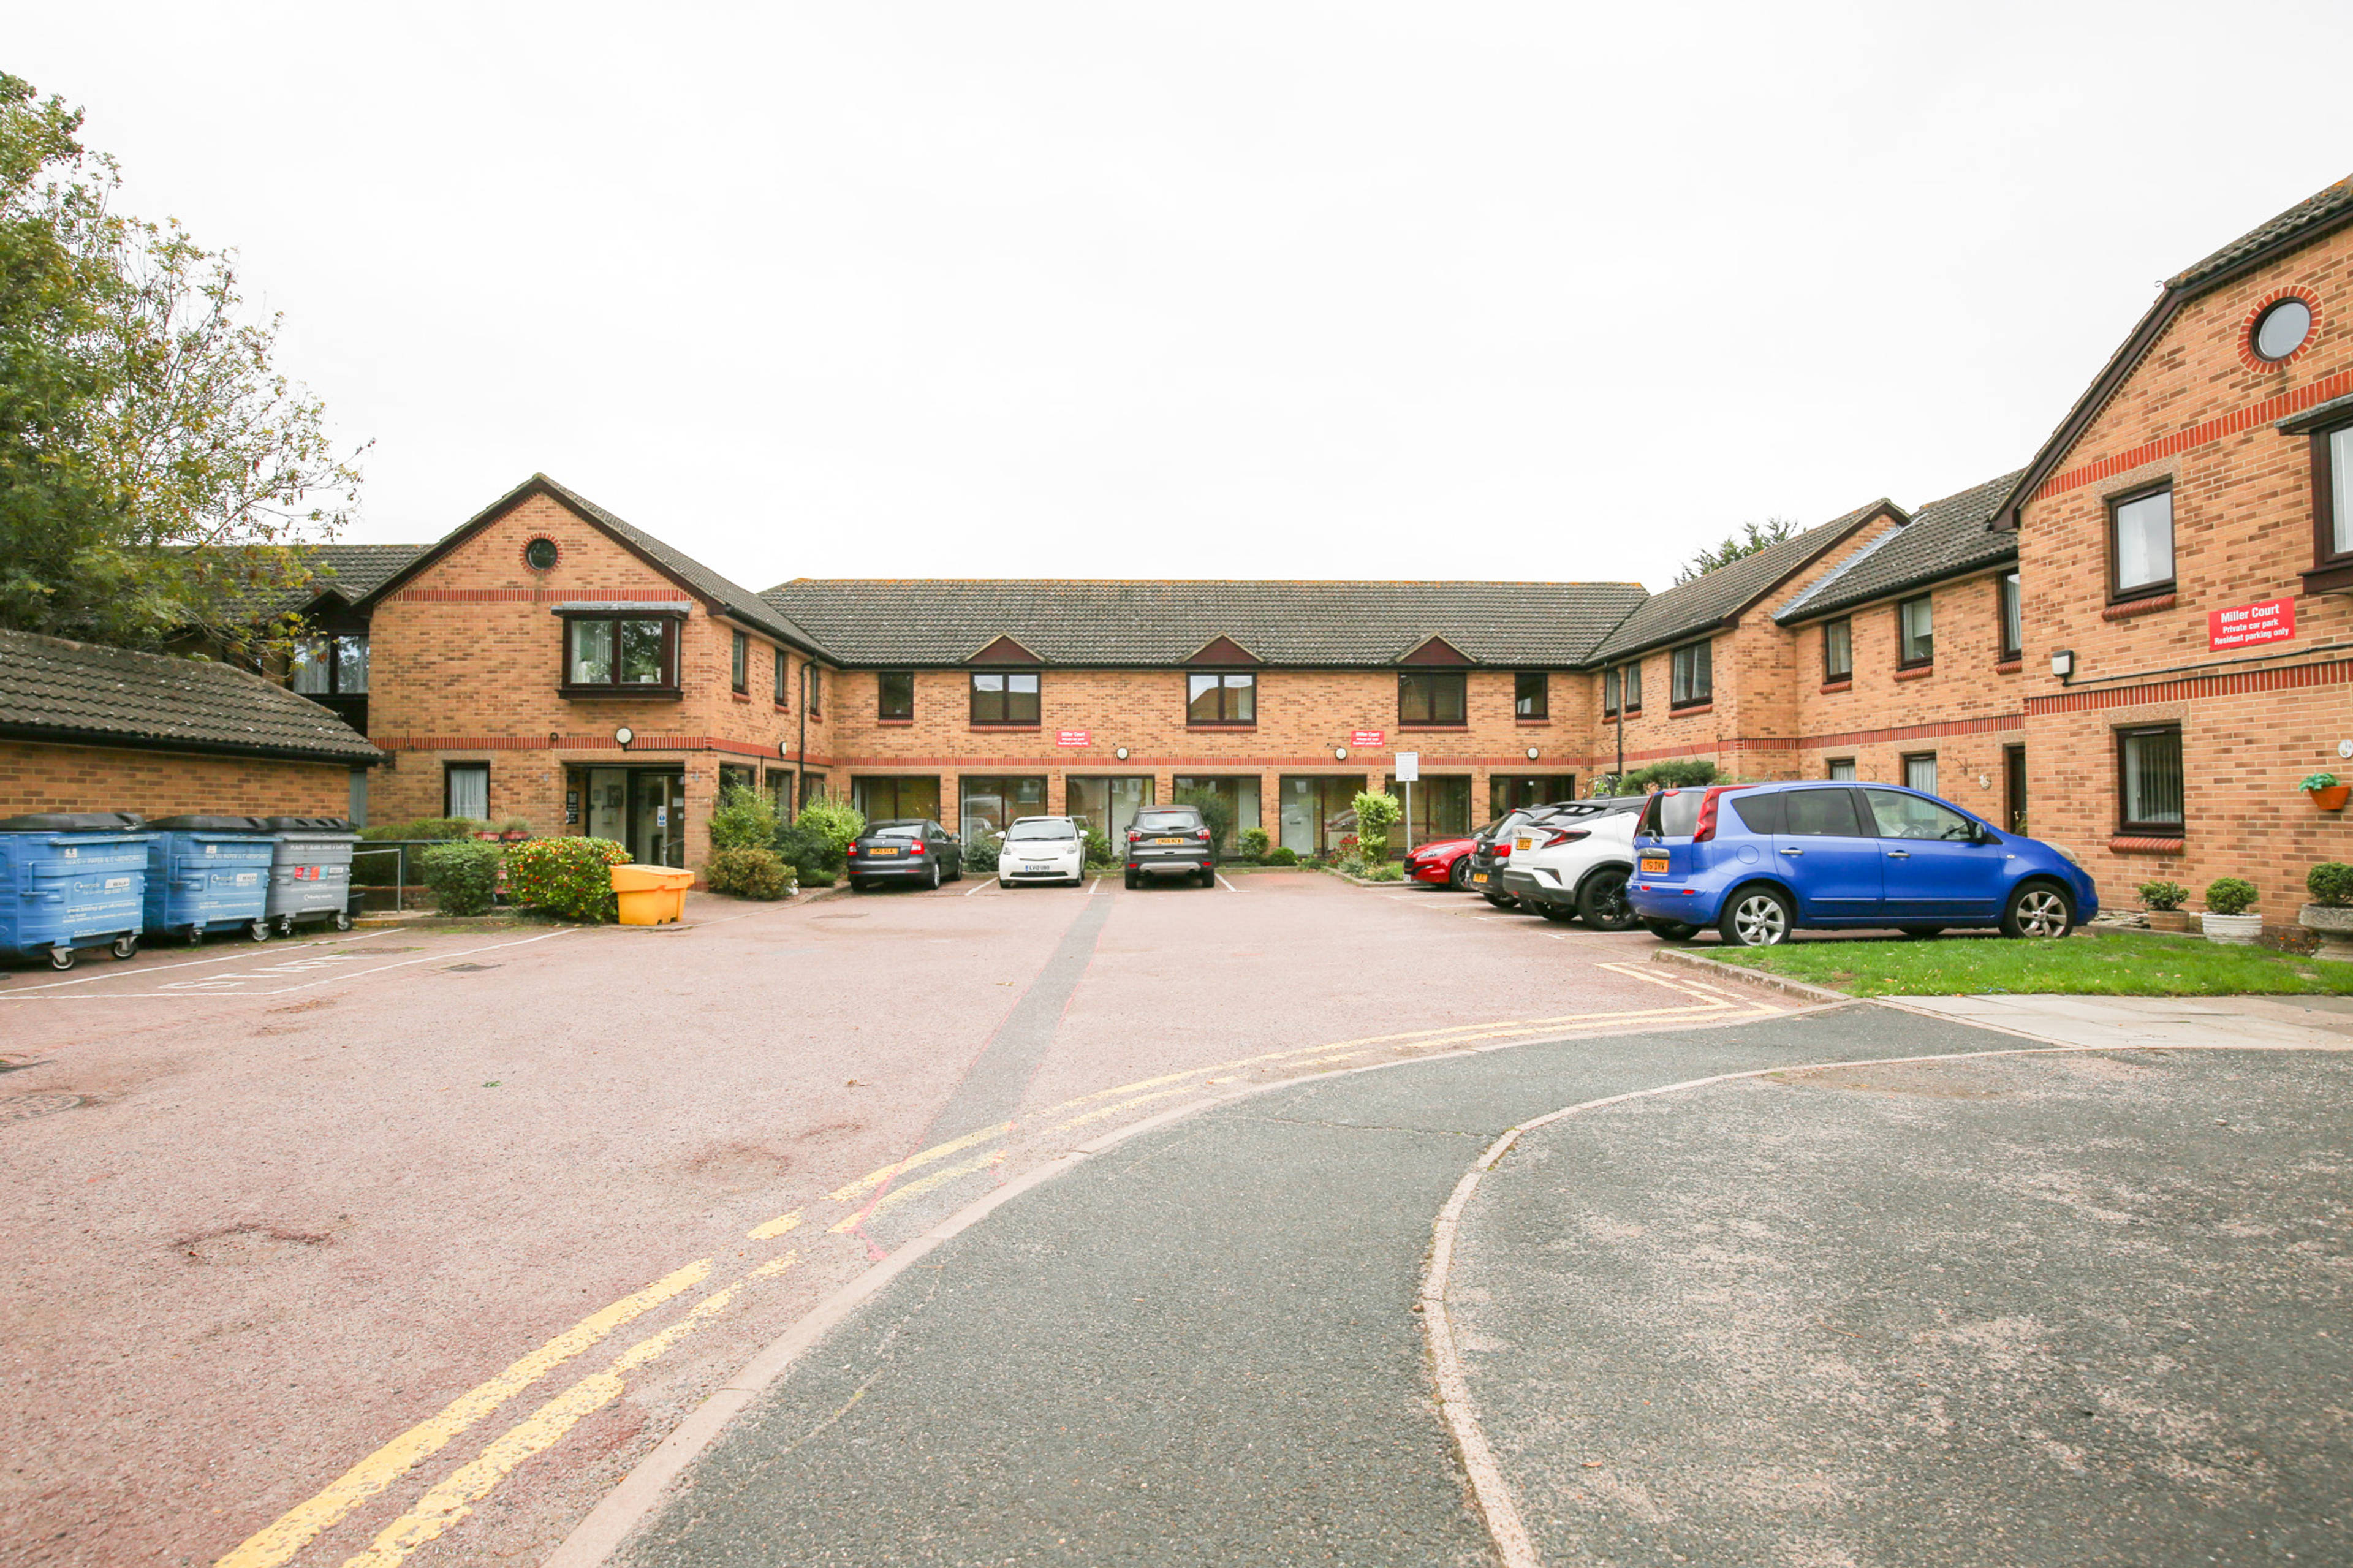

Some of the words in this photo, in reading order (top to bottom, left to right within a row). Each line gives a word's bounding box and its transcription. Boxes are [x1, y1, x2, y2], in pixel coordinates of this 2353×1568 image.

[2221, 610, 2249, 623] Miller
[2251, 604, 2280, 618] Court
[2222, 624, 2247, 634] Private
[2262, 618, 2279, 629] park
[2214, 634, 2243, 645] Resident
[2245, 631, 2272, 642] parking
[2273, 627, 2289, 636] only
